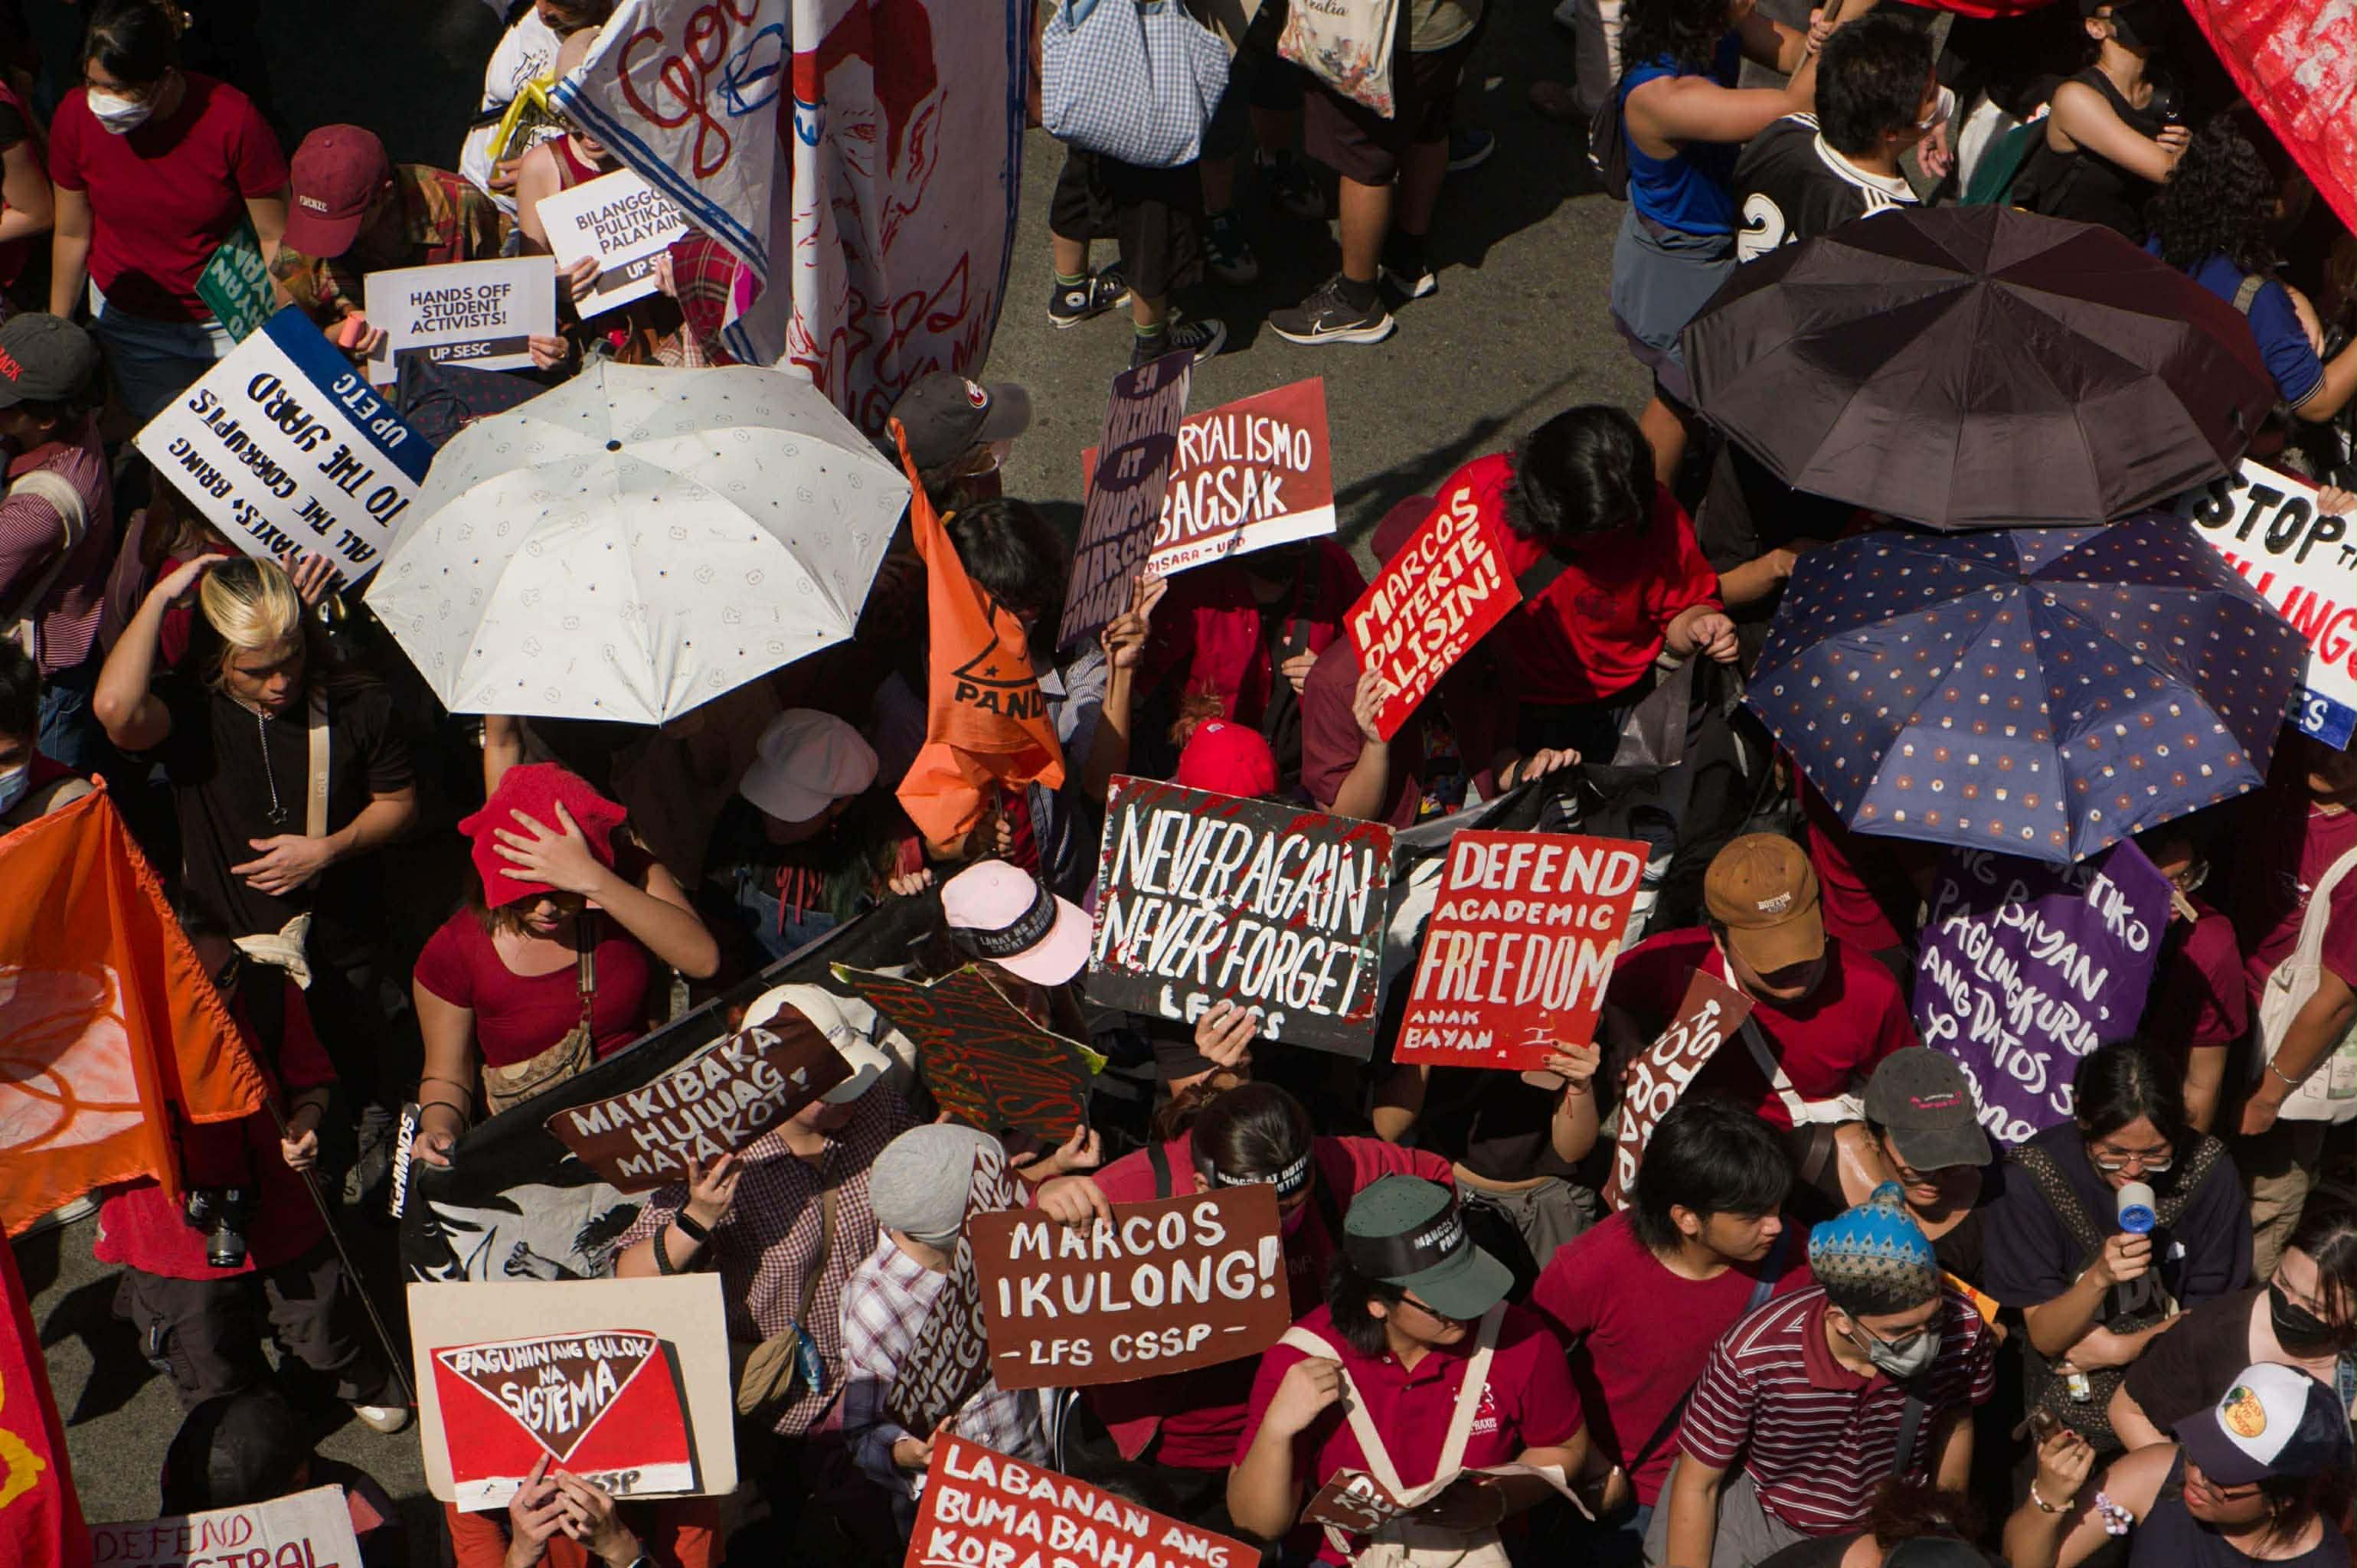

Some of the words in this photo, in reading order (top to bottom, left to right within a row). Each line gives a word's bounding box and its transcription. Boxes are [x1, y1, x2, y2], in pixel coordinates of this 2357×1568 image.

[595, 202, 680, 240] PULITIKAL
[1736, 192, 1785, 263] 2
[410, 286, 473, 306] HANDS
[478, 283, 512, 299] OFF
[626, 265, 649, 279] UP
[410, 311, 507, 335] ACTIVISTS!
[421, 299, 502, 318] STUDENT
[430, 346, 450, 361] UP
[453, 342, 491, 358] SESC
[247, 373, 332, 452] YARD
[332, 373, 382, 421] ETC
[188, 388, 299, 499] CORRUPTS
[369, 416, 410, 449] UP
[1117, 446, 1146, 479] AT
[1169, 413, 1312, 480] RYALISMO
[168, 436, 234, 499] BRING
[318, 443, 375, 499] THE
[293, 495, 338, 536] THE
[365, 485, 410, 528] TO
[1153, 465, 1287, 547] BAGSAK
[2193, 470, 2348, 564] STOP
[335, 528, 378, 564] ALL
[1067, 521, 1157, 608] MARCOS
[1355, 486, 1479, 651] MARCOS
[1365, 522, 1486, 671] DUTERTE
[1111, 803, 1254, 910] NEVER
[1232, 831, 1373, 935] AGAIN
[1450, 841, 1639, 897] DEFEND
[1435, 898, 1615, 930] ACADEMIC
[1097, 893, 1228, 985] NEVER
[1218, 919, 1375, 1018] FORGET
[1414, 929, 1621, 1011] FREEDOM
[1403, 1027, 1493, 1050] BAYAN
[1410, 1009, 1481, 1024] ANAK
[1921, 946, 1972, 1018] ANG
[1969, 988, 2052, 1094] DATOS
[2051, 1083, 2075, 1119] S
[570, 1027, 783, 1137] MAKIBAKA
[631, 1060, 786, 1150] HUWAG
[1009, 1201, 1226, 1261] MARCOS
[999, 1235, 1280, 1318] IKULONG!
[888, 1235, 973, 1412] SERBISYO
[1030, 1338, 1094, 1366] LFS
[1110, 1324, 1212, 1363] CSSP
[456, 1342, 551, 1376] BAGUHIN
[551, 1341, 584, 1361] ANG
[587, 1337, 649, 1362] BULOK
[538, 1364, 566, 1385] NA
[901, 1304, 968, 1425] HUWAG
[501, 1359, 618, 1434] SISTEMA
[943, 1444, 1150, 1539] LABANAN
[1160, 1527, 1229, 1566] ANG
[93, 1514, 253, 1563] DEFEND
